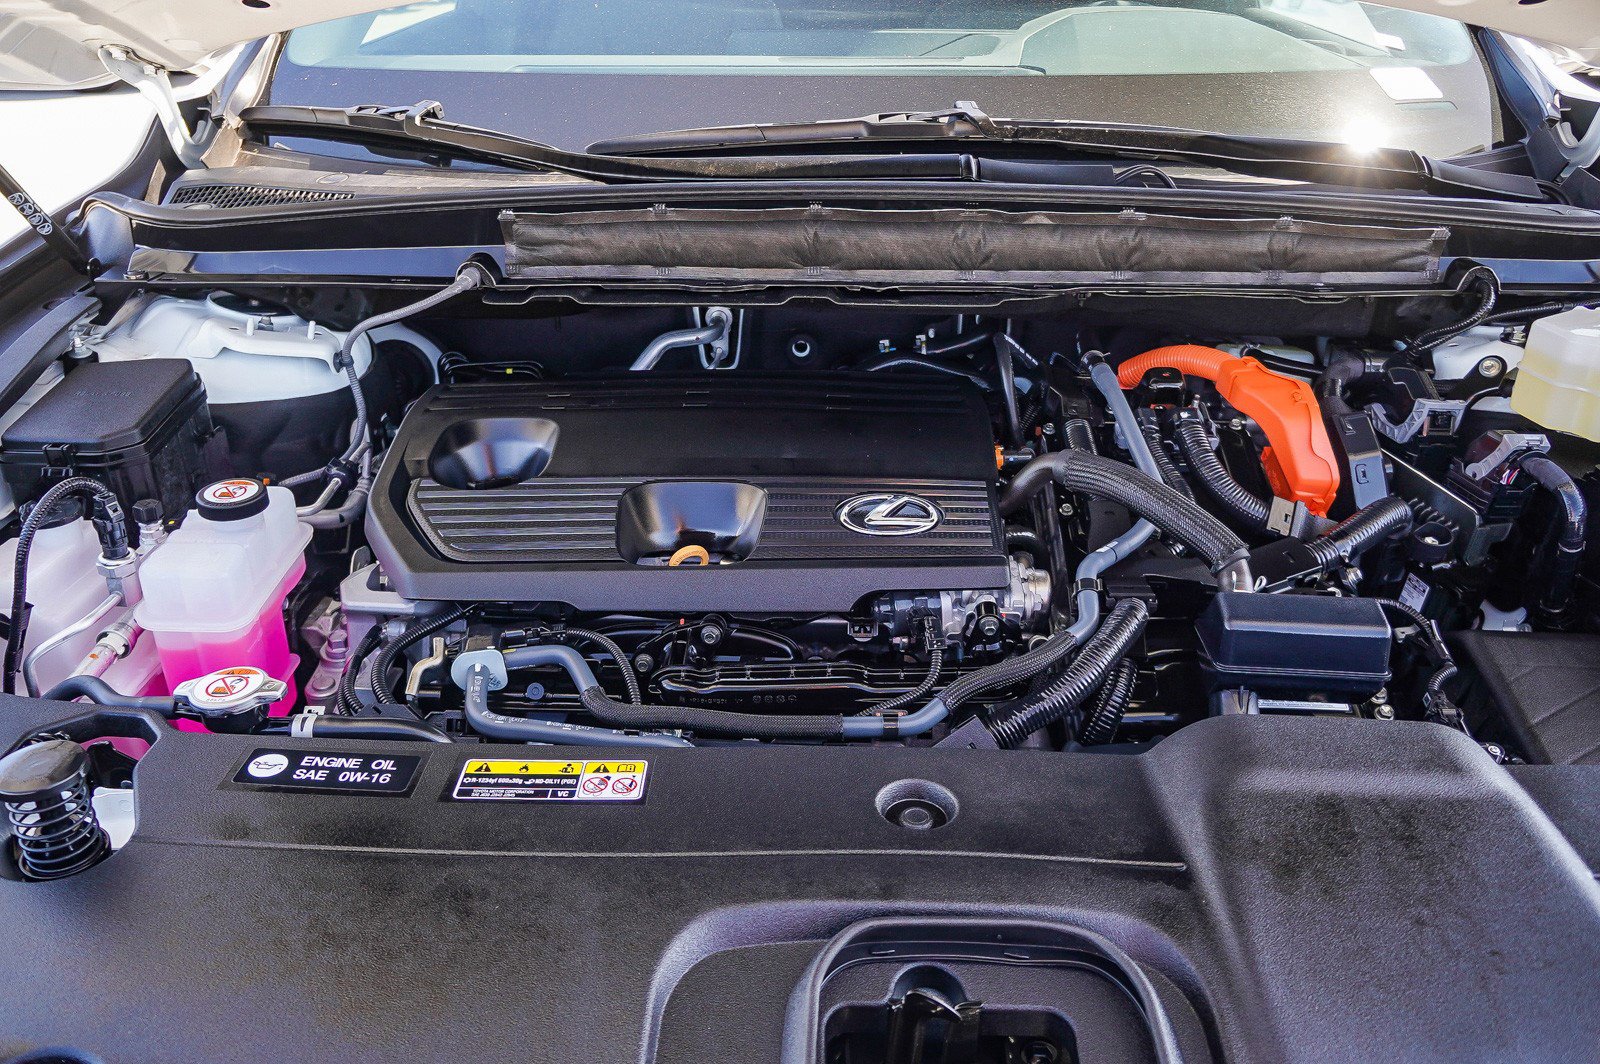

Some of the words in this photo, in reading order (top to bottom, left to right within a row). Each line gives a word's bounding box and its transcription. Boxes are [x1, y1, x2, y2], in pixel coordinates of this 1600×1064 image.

[300, 756, 363, 768] ENGINE
[371, 759, 397, 770] OIL
[292, 769, 329, 780] SAE
[338, 771, 392, 784] 0W-16
